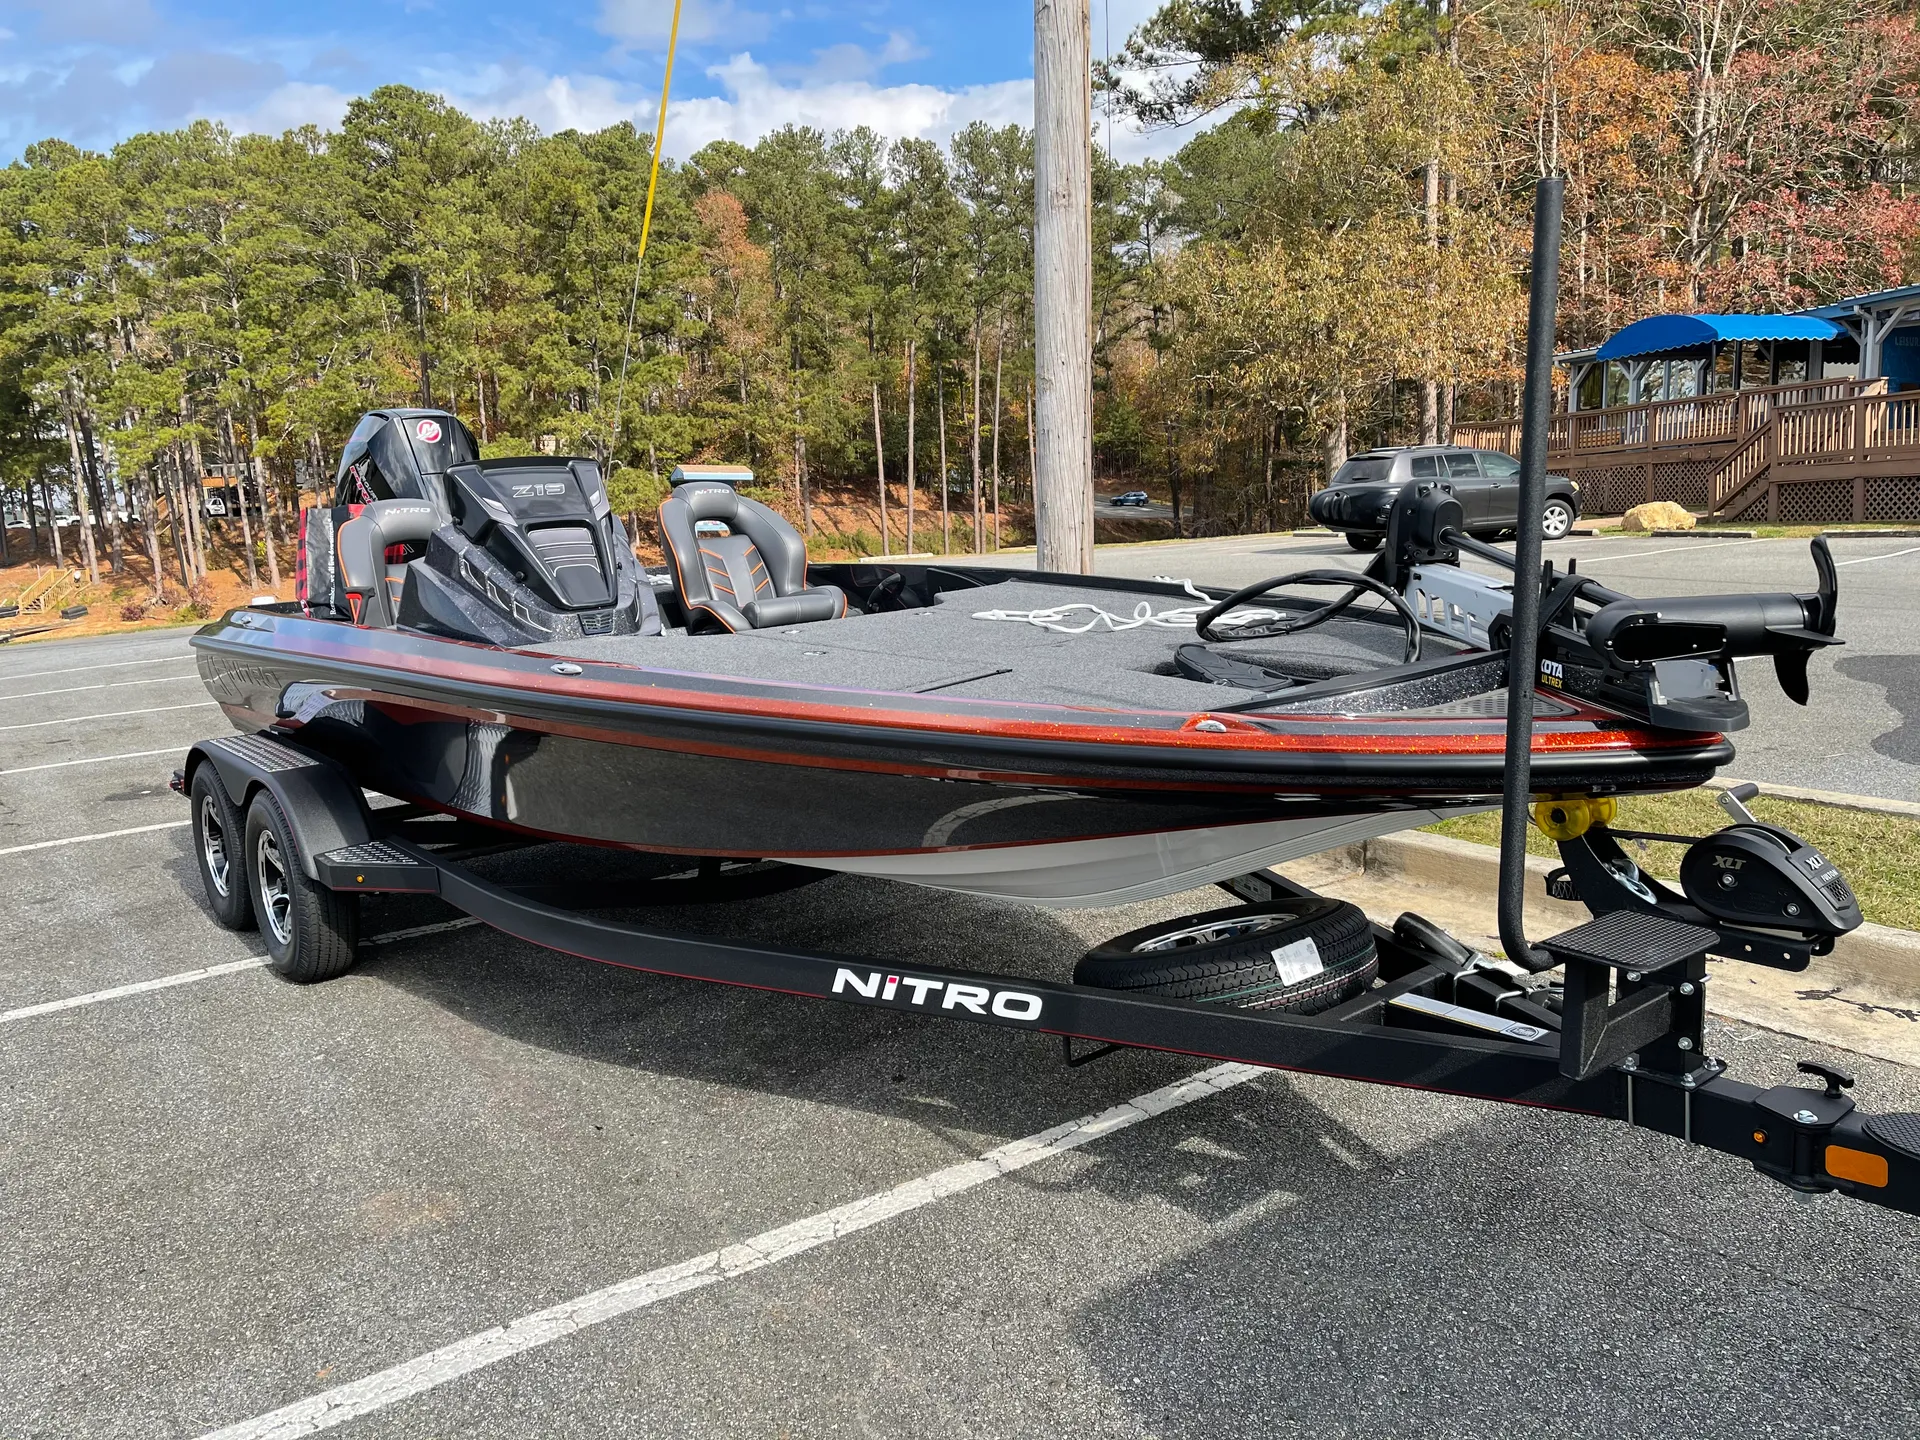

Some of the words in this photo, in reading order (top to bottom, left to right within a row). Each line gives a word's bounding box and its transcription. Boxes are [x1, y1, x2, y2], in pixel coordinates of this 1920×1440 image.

[512, 482, 566, 498] Z19
[1541, 674, 1563, 689] ULTREX
[1712, 855, 1747, 870] XLT
[1805, 854, 1824, 870] XLT
